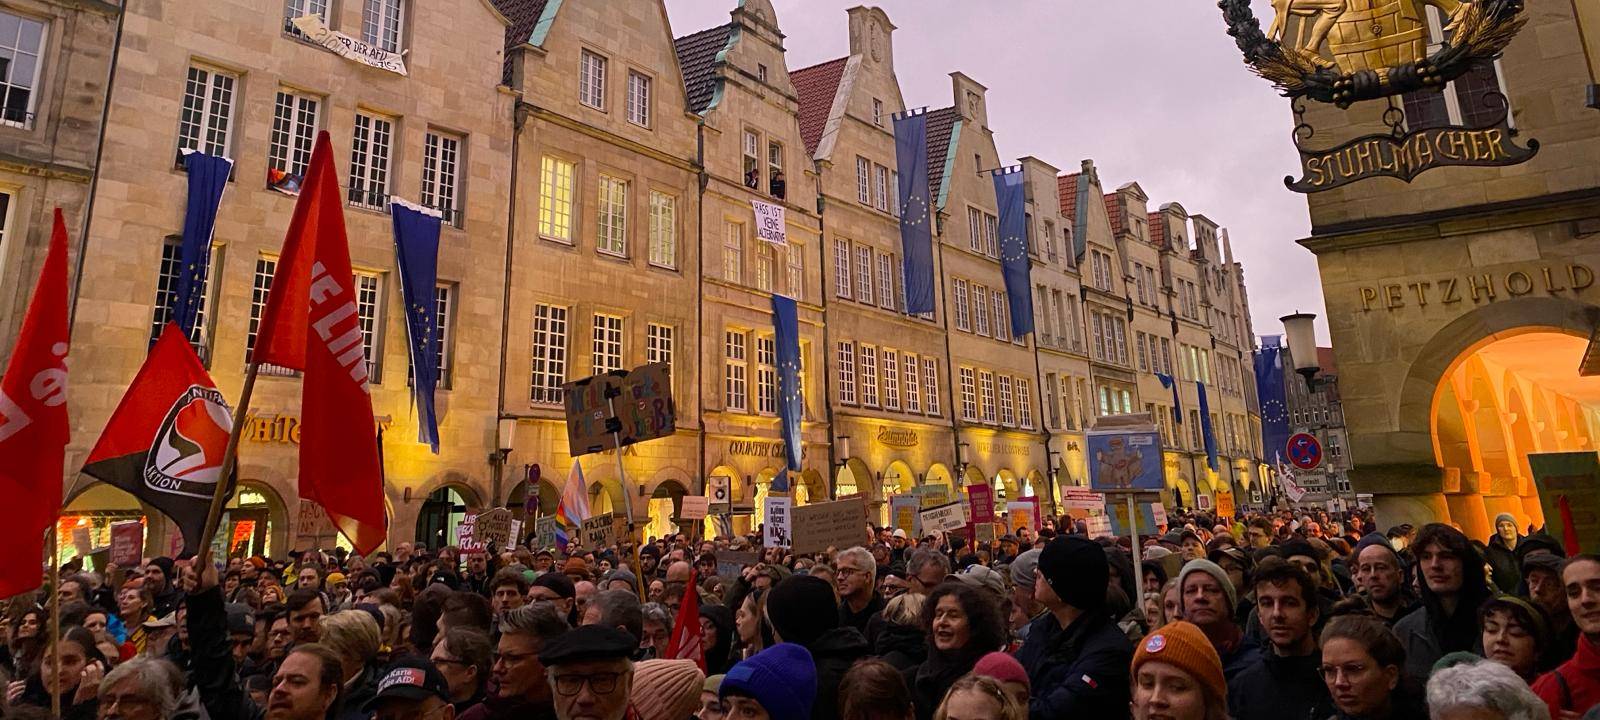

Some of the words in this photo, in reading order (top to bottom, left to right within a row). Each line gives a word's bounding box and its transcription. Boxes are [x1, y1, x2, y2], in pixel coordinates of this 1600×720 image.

[1306, 128, 1510, 187] STUHLMACHER
[771, 206, 781, 218] IST
[1358, 263, 1595, 312] PETZHOLD
[146, 465, 182, 490] AKTION
